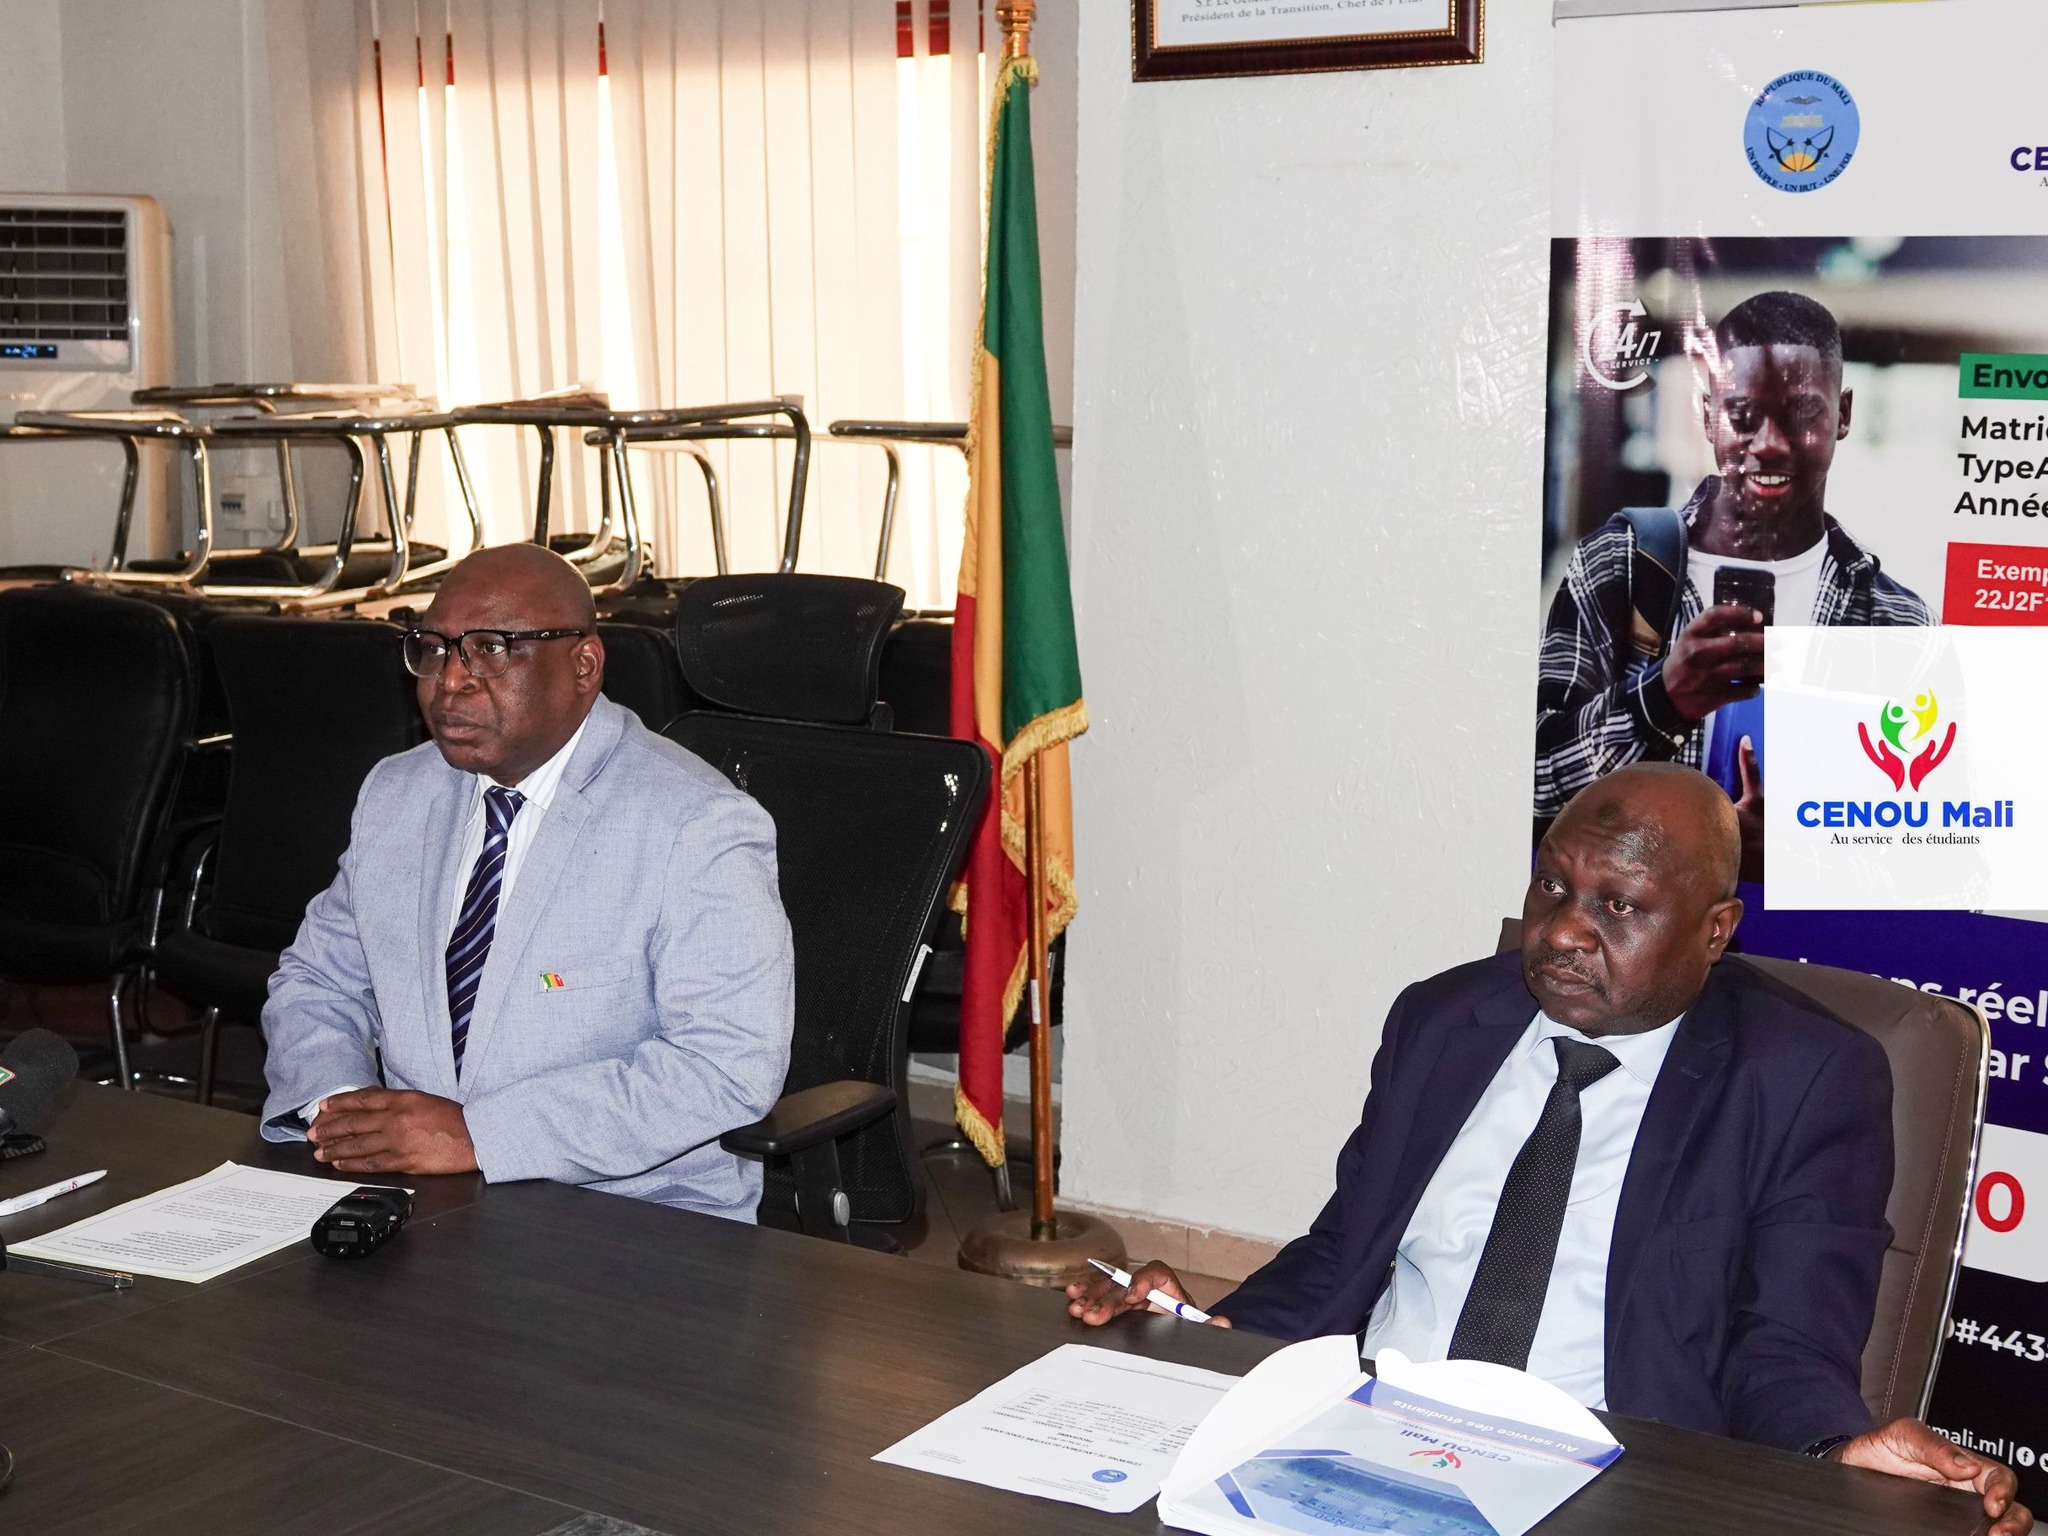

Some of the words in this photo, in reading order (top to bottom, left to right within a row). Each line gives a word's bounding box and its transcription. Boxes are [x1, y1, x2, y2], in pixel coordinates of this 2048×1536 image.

[1181, 11, 1234, 22] Président
[1238, 9, 1252, 18] de
[1255, 7, 1266, 16] la
[1270, 3, 1333, 15] Transition,
[1337, 0, 1366, 9] Chef
[1816, 73, 1831, 86] DU
[1830, 82, 1852, 106] MALI
[1752, 158, 1780, 188] PEUPLE
[1784, 183, 1799, 193] UN
[1799, 181, 1818, 193] BUT
[1823, 170, 1841, 184] UNE
[1838, 152, 1853, 168] FOI
[1973, 364, 2048, 389] Envo
[1961, 415, 2048, 441] Matri
[1974, 589, 2048, 612] 22J2F
[1958, 982, 2048, 1028] réel
[1989, 1048, 2031, 1081] ar
[1945, 1316, 2048, 1362] #443
[1392, 1399, 1463, 1425] étudiants
[1400, 1429, 1440, 1446] Mali
[1466, 1420, 1494, 1433] des
[1497, 1428, 1554, 1446] service
[1442, 1440, 1512, 1463] CENOU
[1556, 1441, 1580, 1453] Au
[1927, 1424, 2004, 1458] mali.ml
